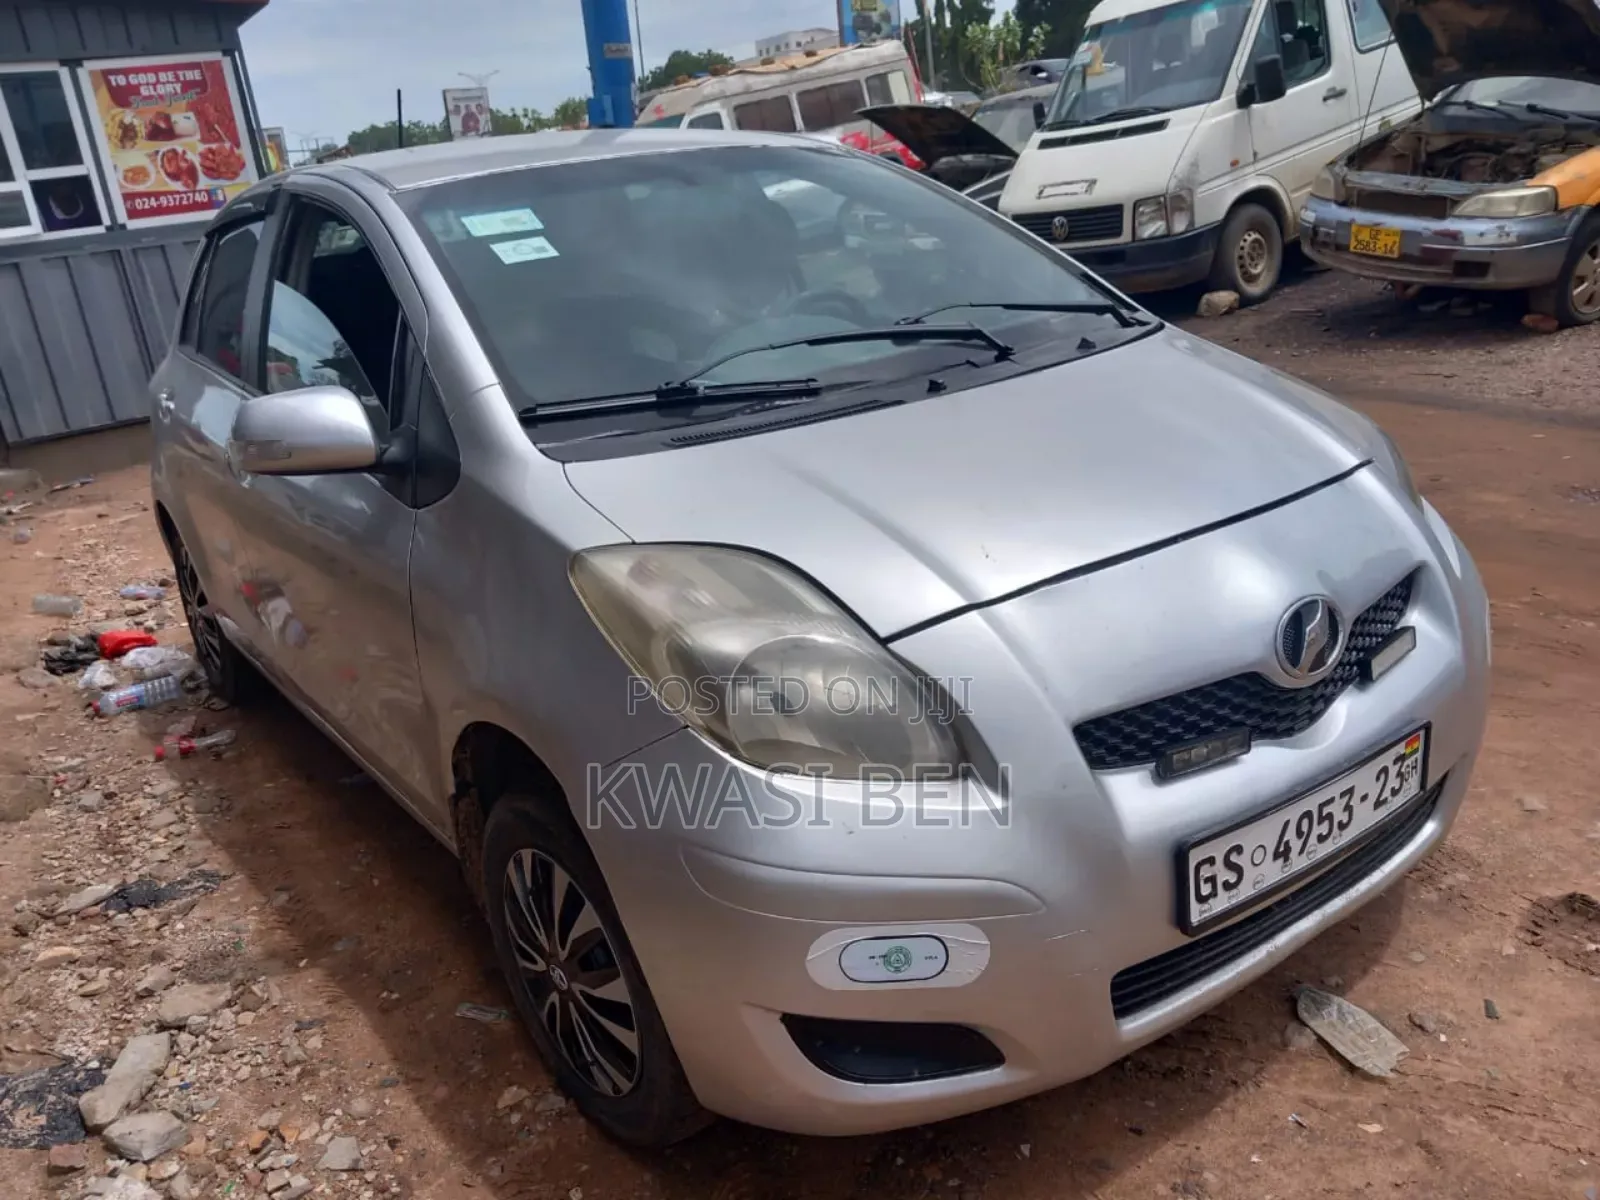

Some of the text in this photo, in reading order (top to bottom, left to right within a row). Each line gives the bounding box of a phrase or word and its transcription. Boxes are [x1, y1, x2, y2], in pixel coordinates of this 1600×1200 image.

[108, 69, 202, 87] TO GOD BE THE
[140, 83, 182, 96] GLORY
[135, 191, 209, 210] 024-9372740
[1404, 756, 1418, 782] GH
[1194, 753, 1406, 905] GS 4953-23
